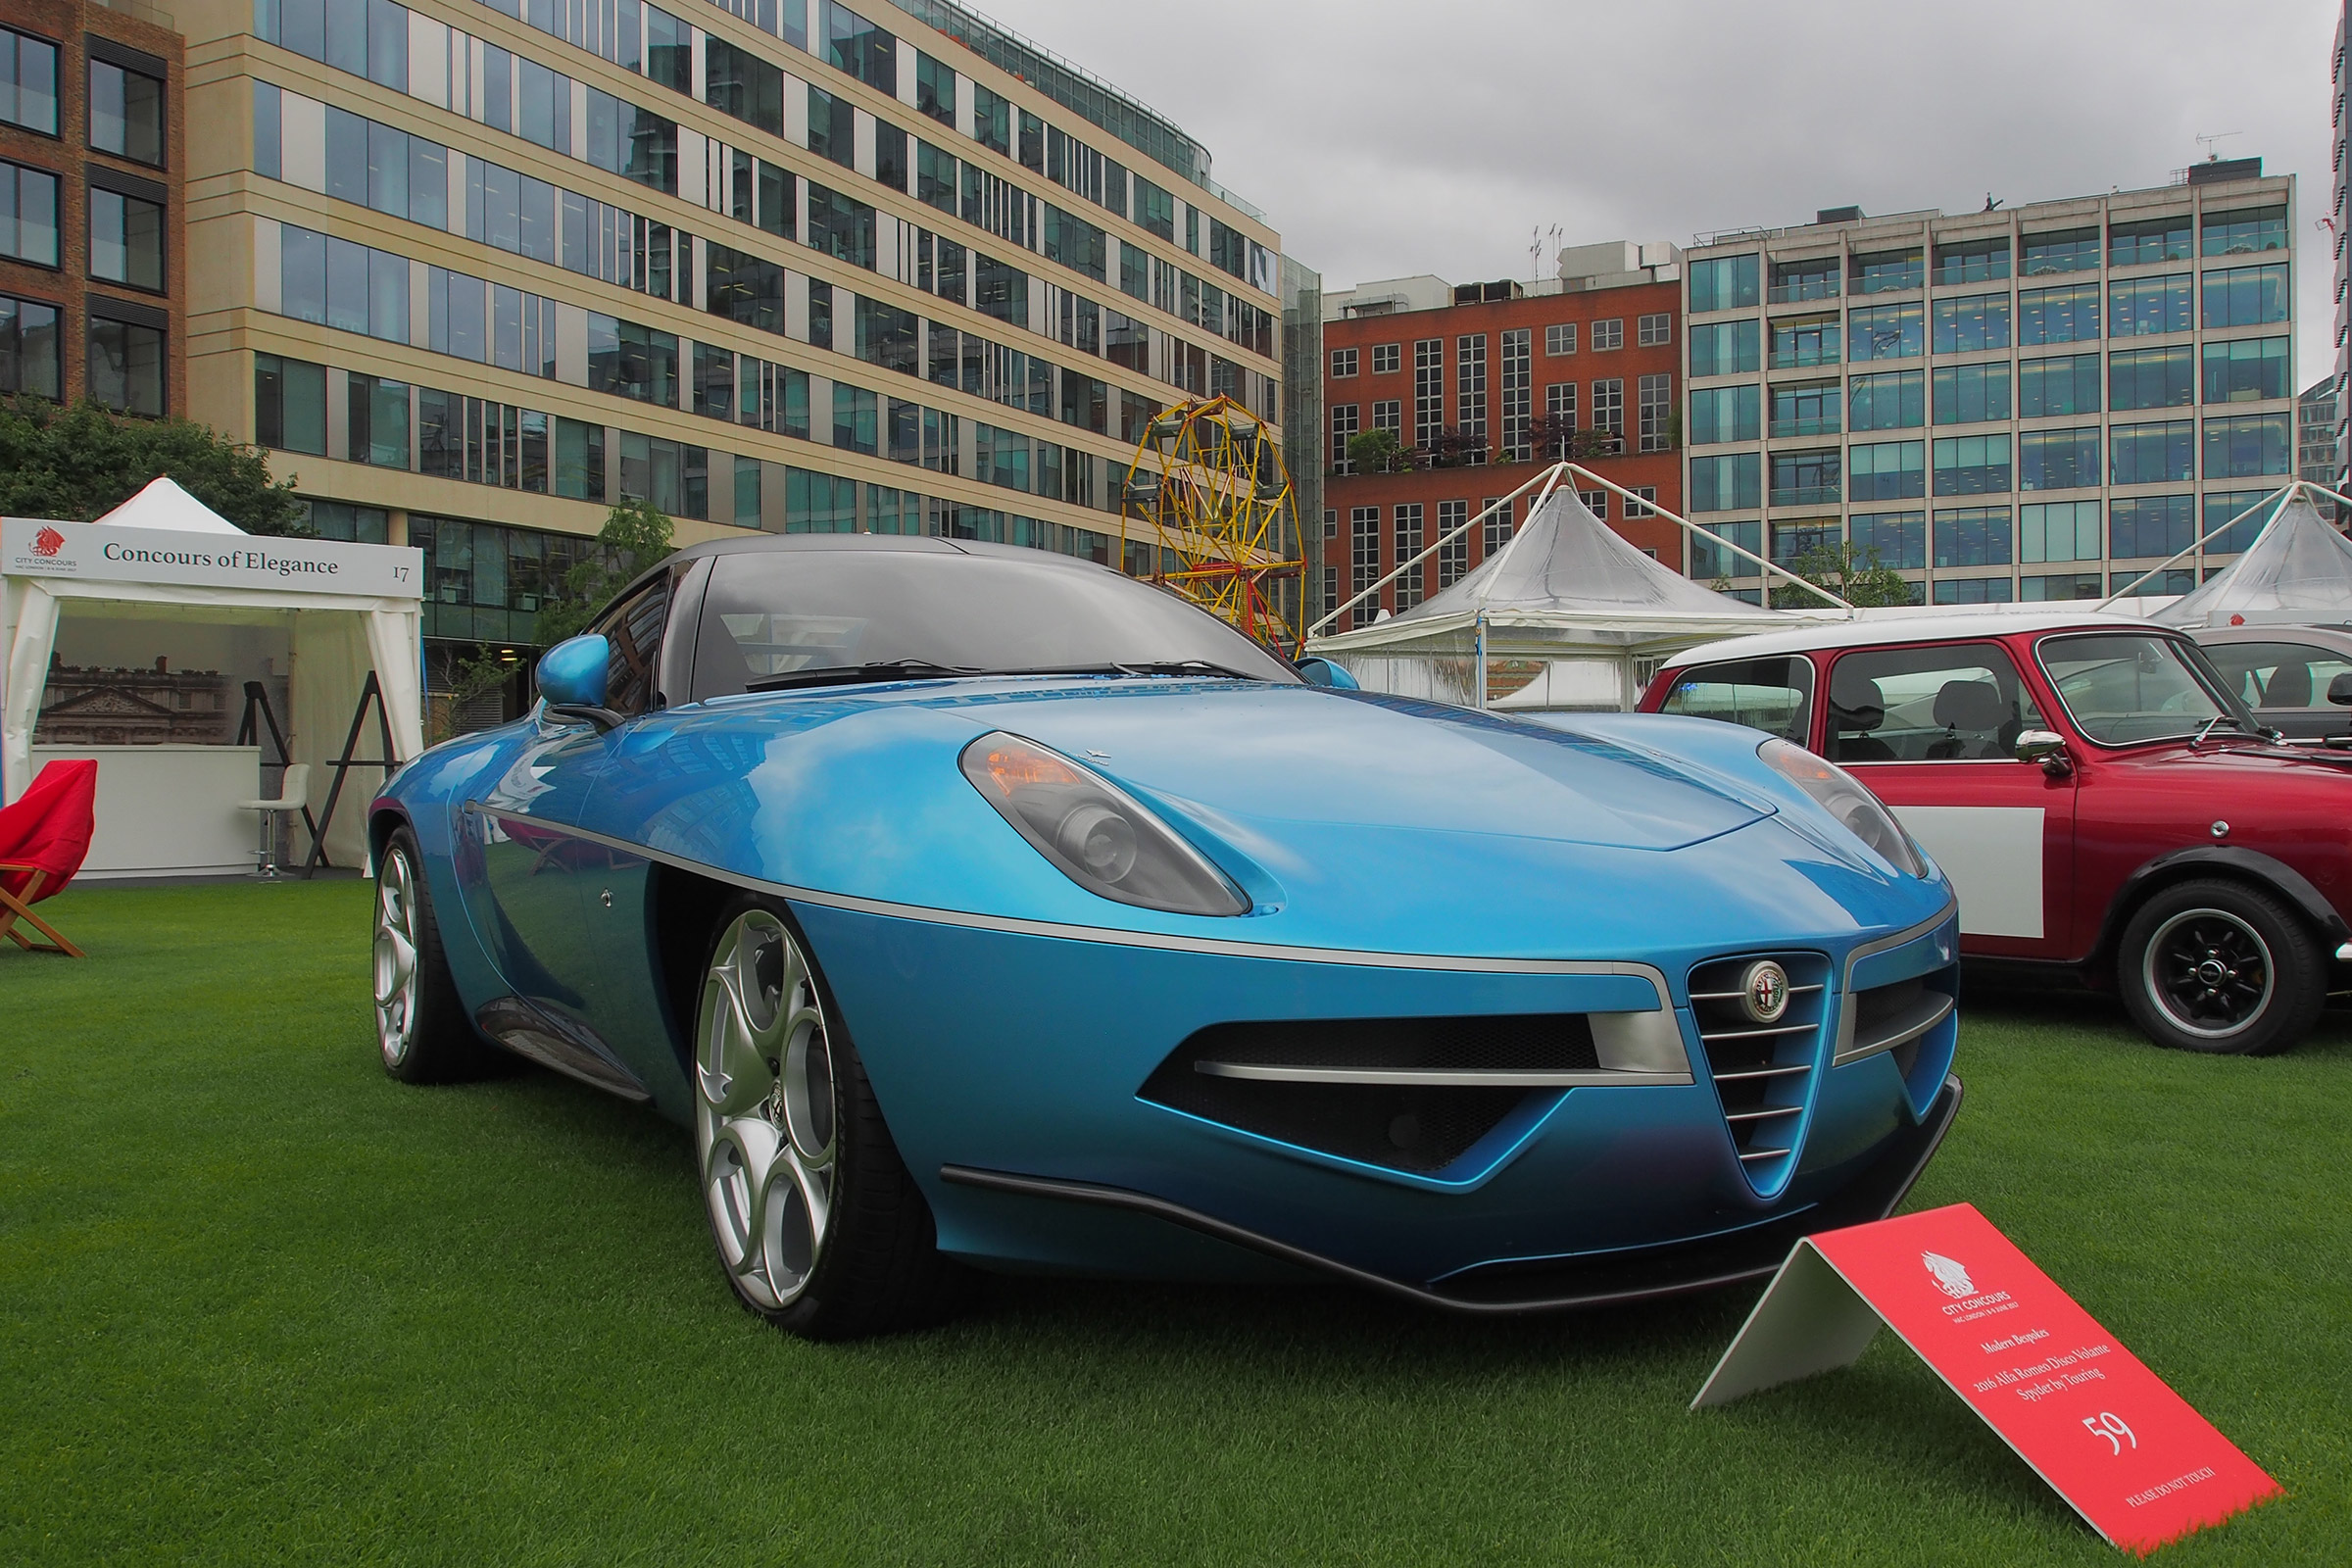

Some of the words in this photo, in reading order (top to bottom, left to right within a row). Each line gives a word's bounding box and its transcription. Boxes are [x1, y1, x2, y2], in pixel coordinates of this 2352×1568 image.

[34, 558, 77, 567] CONCOURS
[103, 542, 212, 566] Concours
[218, 551, 242, 567] of
[245, 552, 339, 576] Elegance
[393, 566, 410, 582] 17
[1941, 1303, 1965, 1315] CITY
[1962, 1291, 2011, 1310] CONCOURS
[1981, 1338, 2015, 1354] Modern
[2012, 1328, 2050, 1345] Bespokes
[1974, 1377, 1998, 1393] 2016
[1994, 1370, 2019, 1387] Alfa
[2013, 1362, 2051, 1380] Romeo
[2046, 1354, 2078, 1369] Disco
[2072, 1344, 2111, 1360] Volante
[2016, 1383, 2055, 1402] Spyder
[2048, 1378, 2069, 1392] by
[2061, 1367, 2106, 1386] Touring
[2082, 1411, 2137, 1456] 59
[2125, 1488, 2159, 1508] PLEASE
[2154, 1484, 2172, 1496] DO
[2168, 1477, 2189, 1492] NOT
[2183, 1466, 2216, 1485] TOUCH
